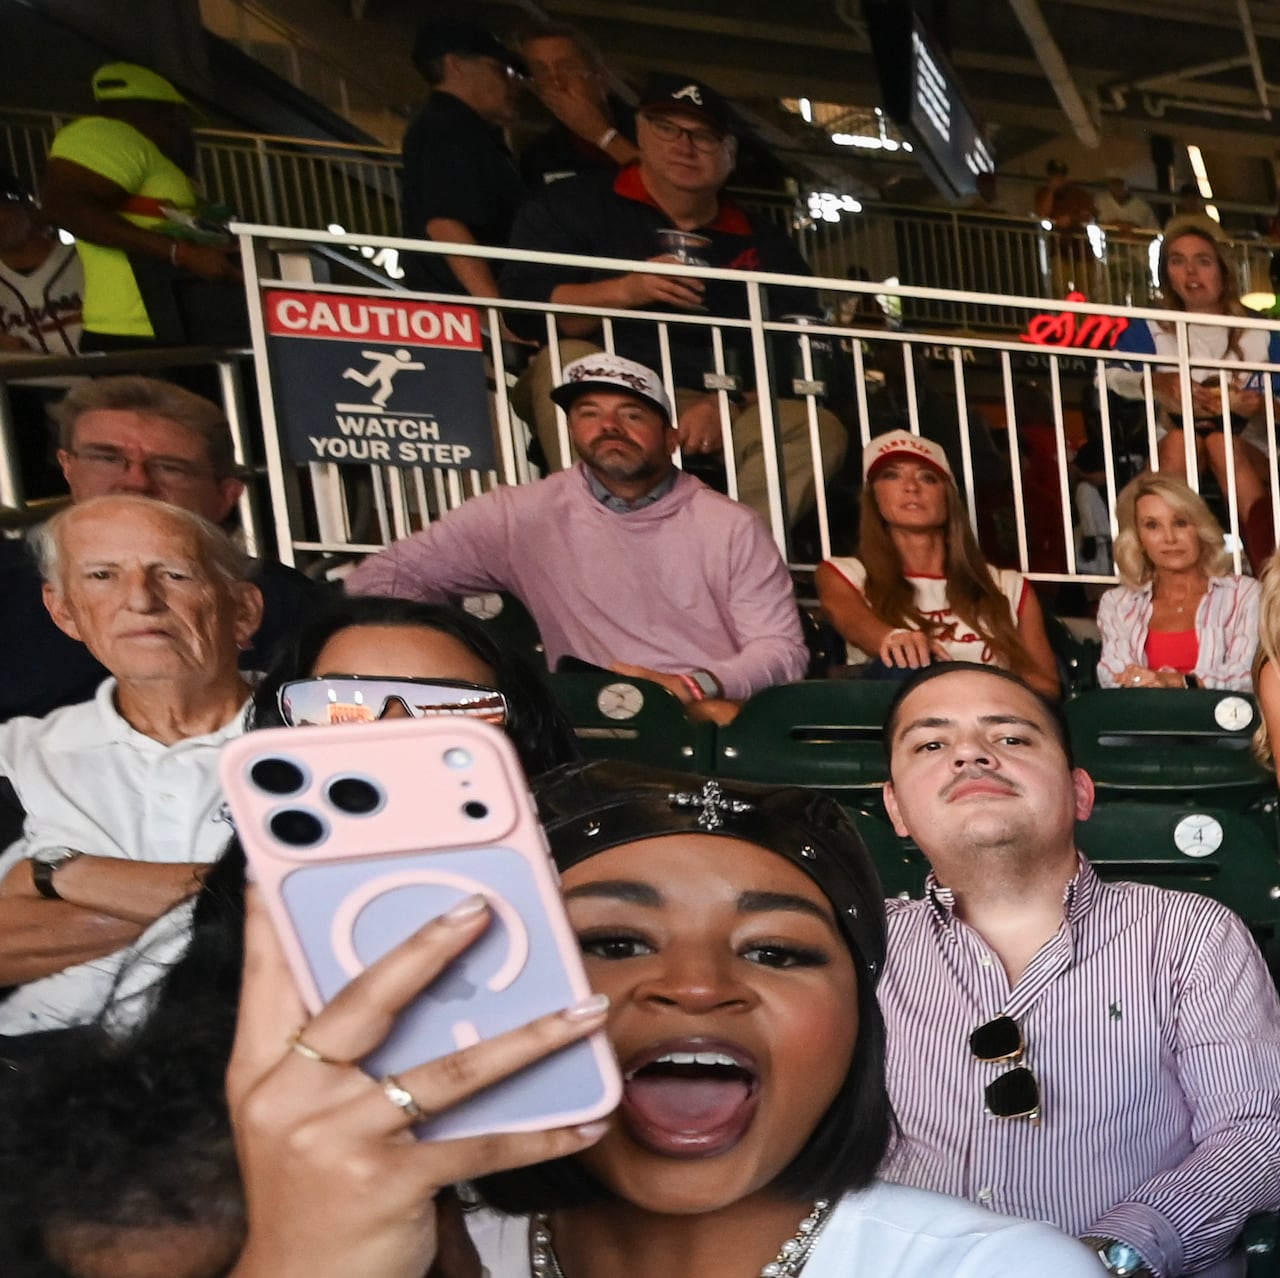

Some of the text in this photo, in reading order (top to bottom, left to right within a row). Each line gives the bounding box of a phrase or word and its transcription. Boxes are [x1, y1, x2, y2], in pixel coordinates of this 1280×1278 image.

[276, 299, 474, 342] CAUTION
[335, 415, 440, 440] WATCH
[308, 436, 472, 465] YOUR STEP
[1192, 827, 1204, 844] 4
